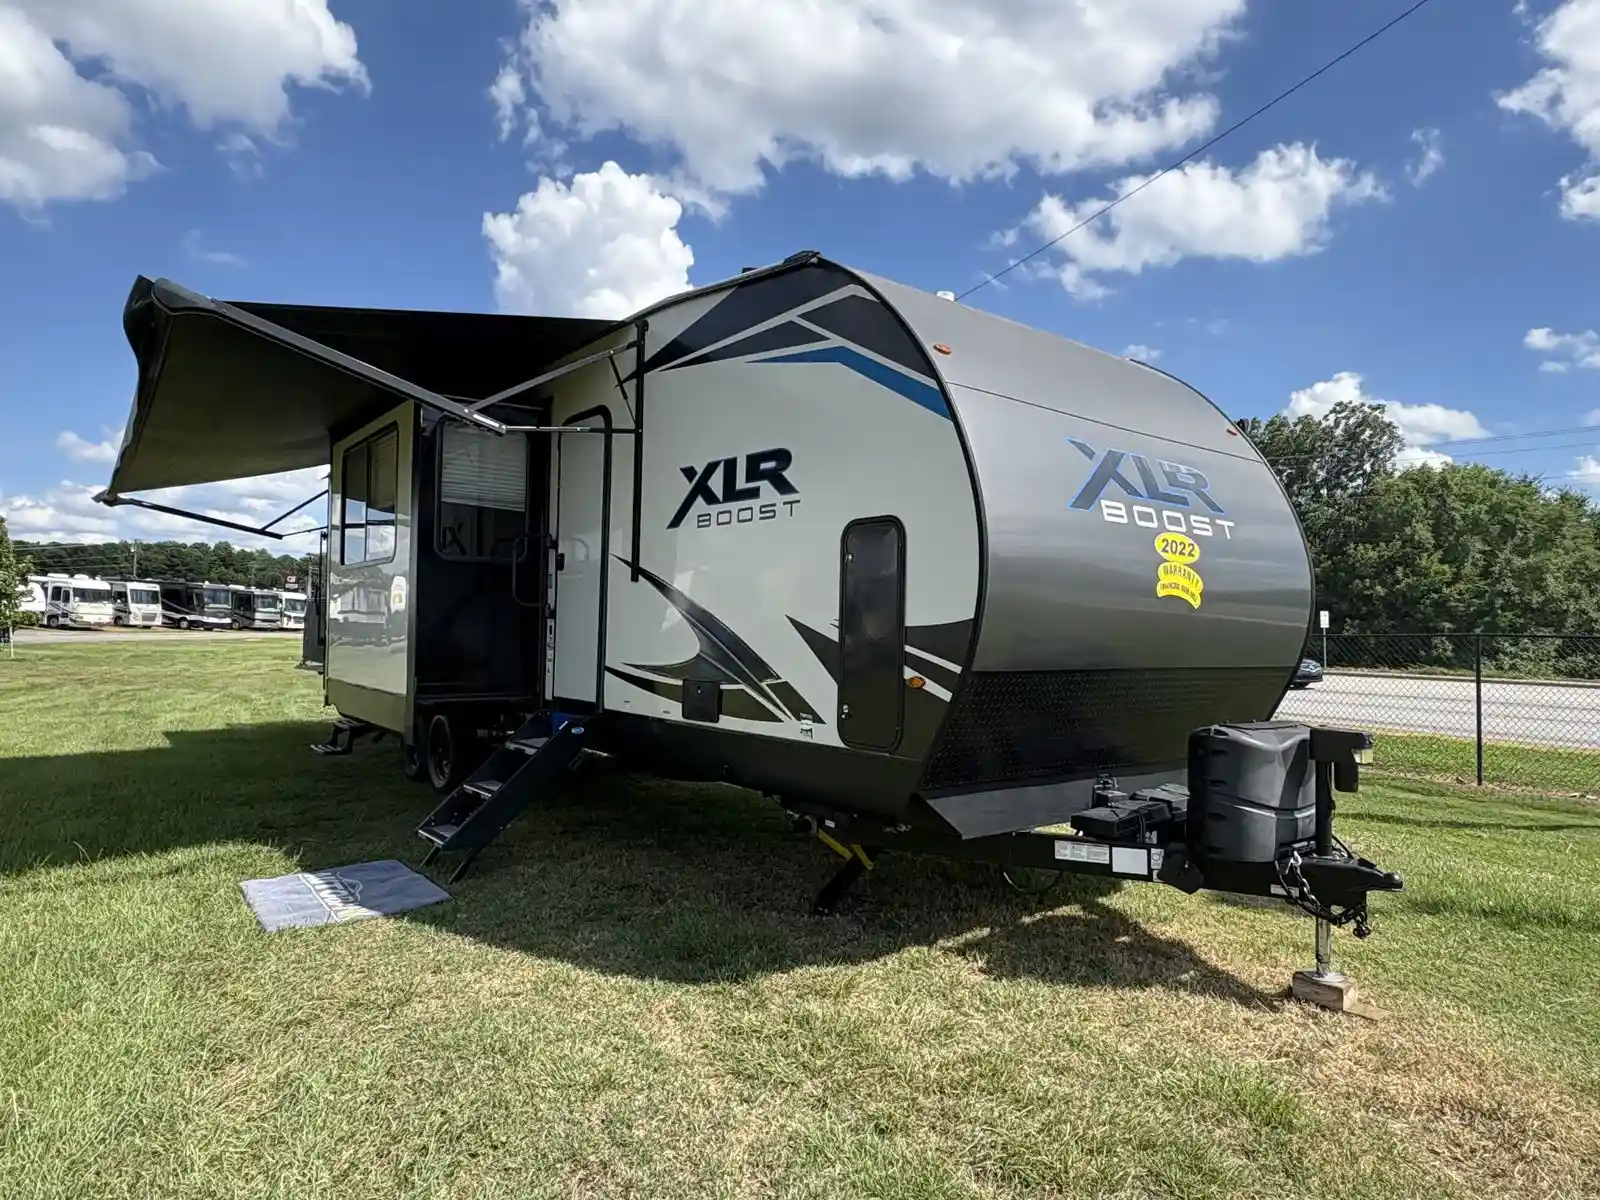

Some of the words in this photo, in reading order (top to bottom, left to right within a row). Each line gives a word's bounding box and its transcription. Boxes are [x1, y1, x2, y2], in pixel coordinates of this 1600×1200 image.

[665, 447, 800, 530] XLR
[1065, 436, 1228, 515] XLR
[697, 499, 801, 529] BOOST
[1100, 499, 1235, 540] BOOST
[1160, 538, 1195, 558] 2022
[1162, 564, 1200, 588] WARRANTY
